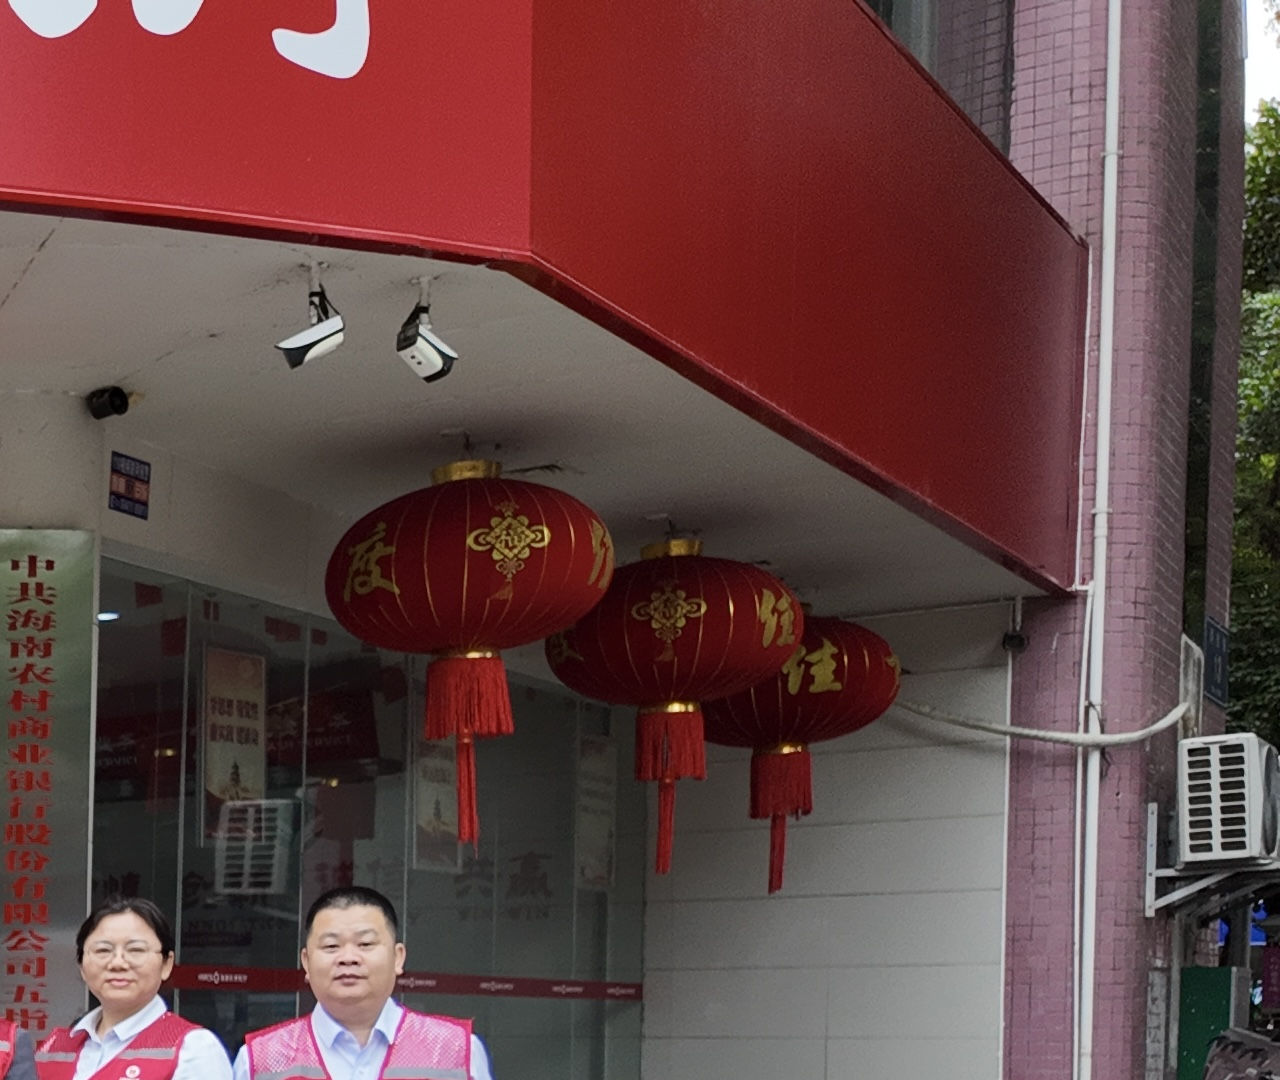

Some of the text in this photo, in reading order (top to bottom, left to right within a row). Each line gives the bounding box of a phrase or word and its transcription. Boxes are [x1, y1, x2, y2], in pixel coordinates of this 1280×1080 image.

[342, 521, 401, 603] 度
[0, 555, 58, 1055] 中共海南农村商业银行股份有限公司五指
